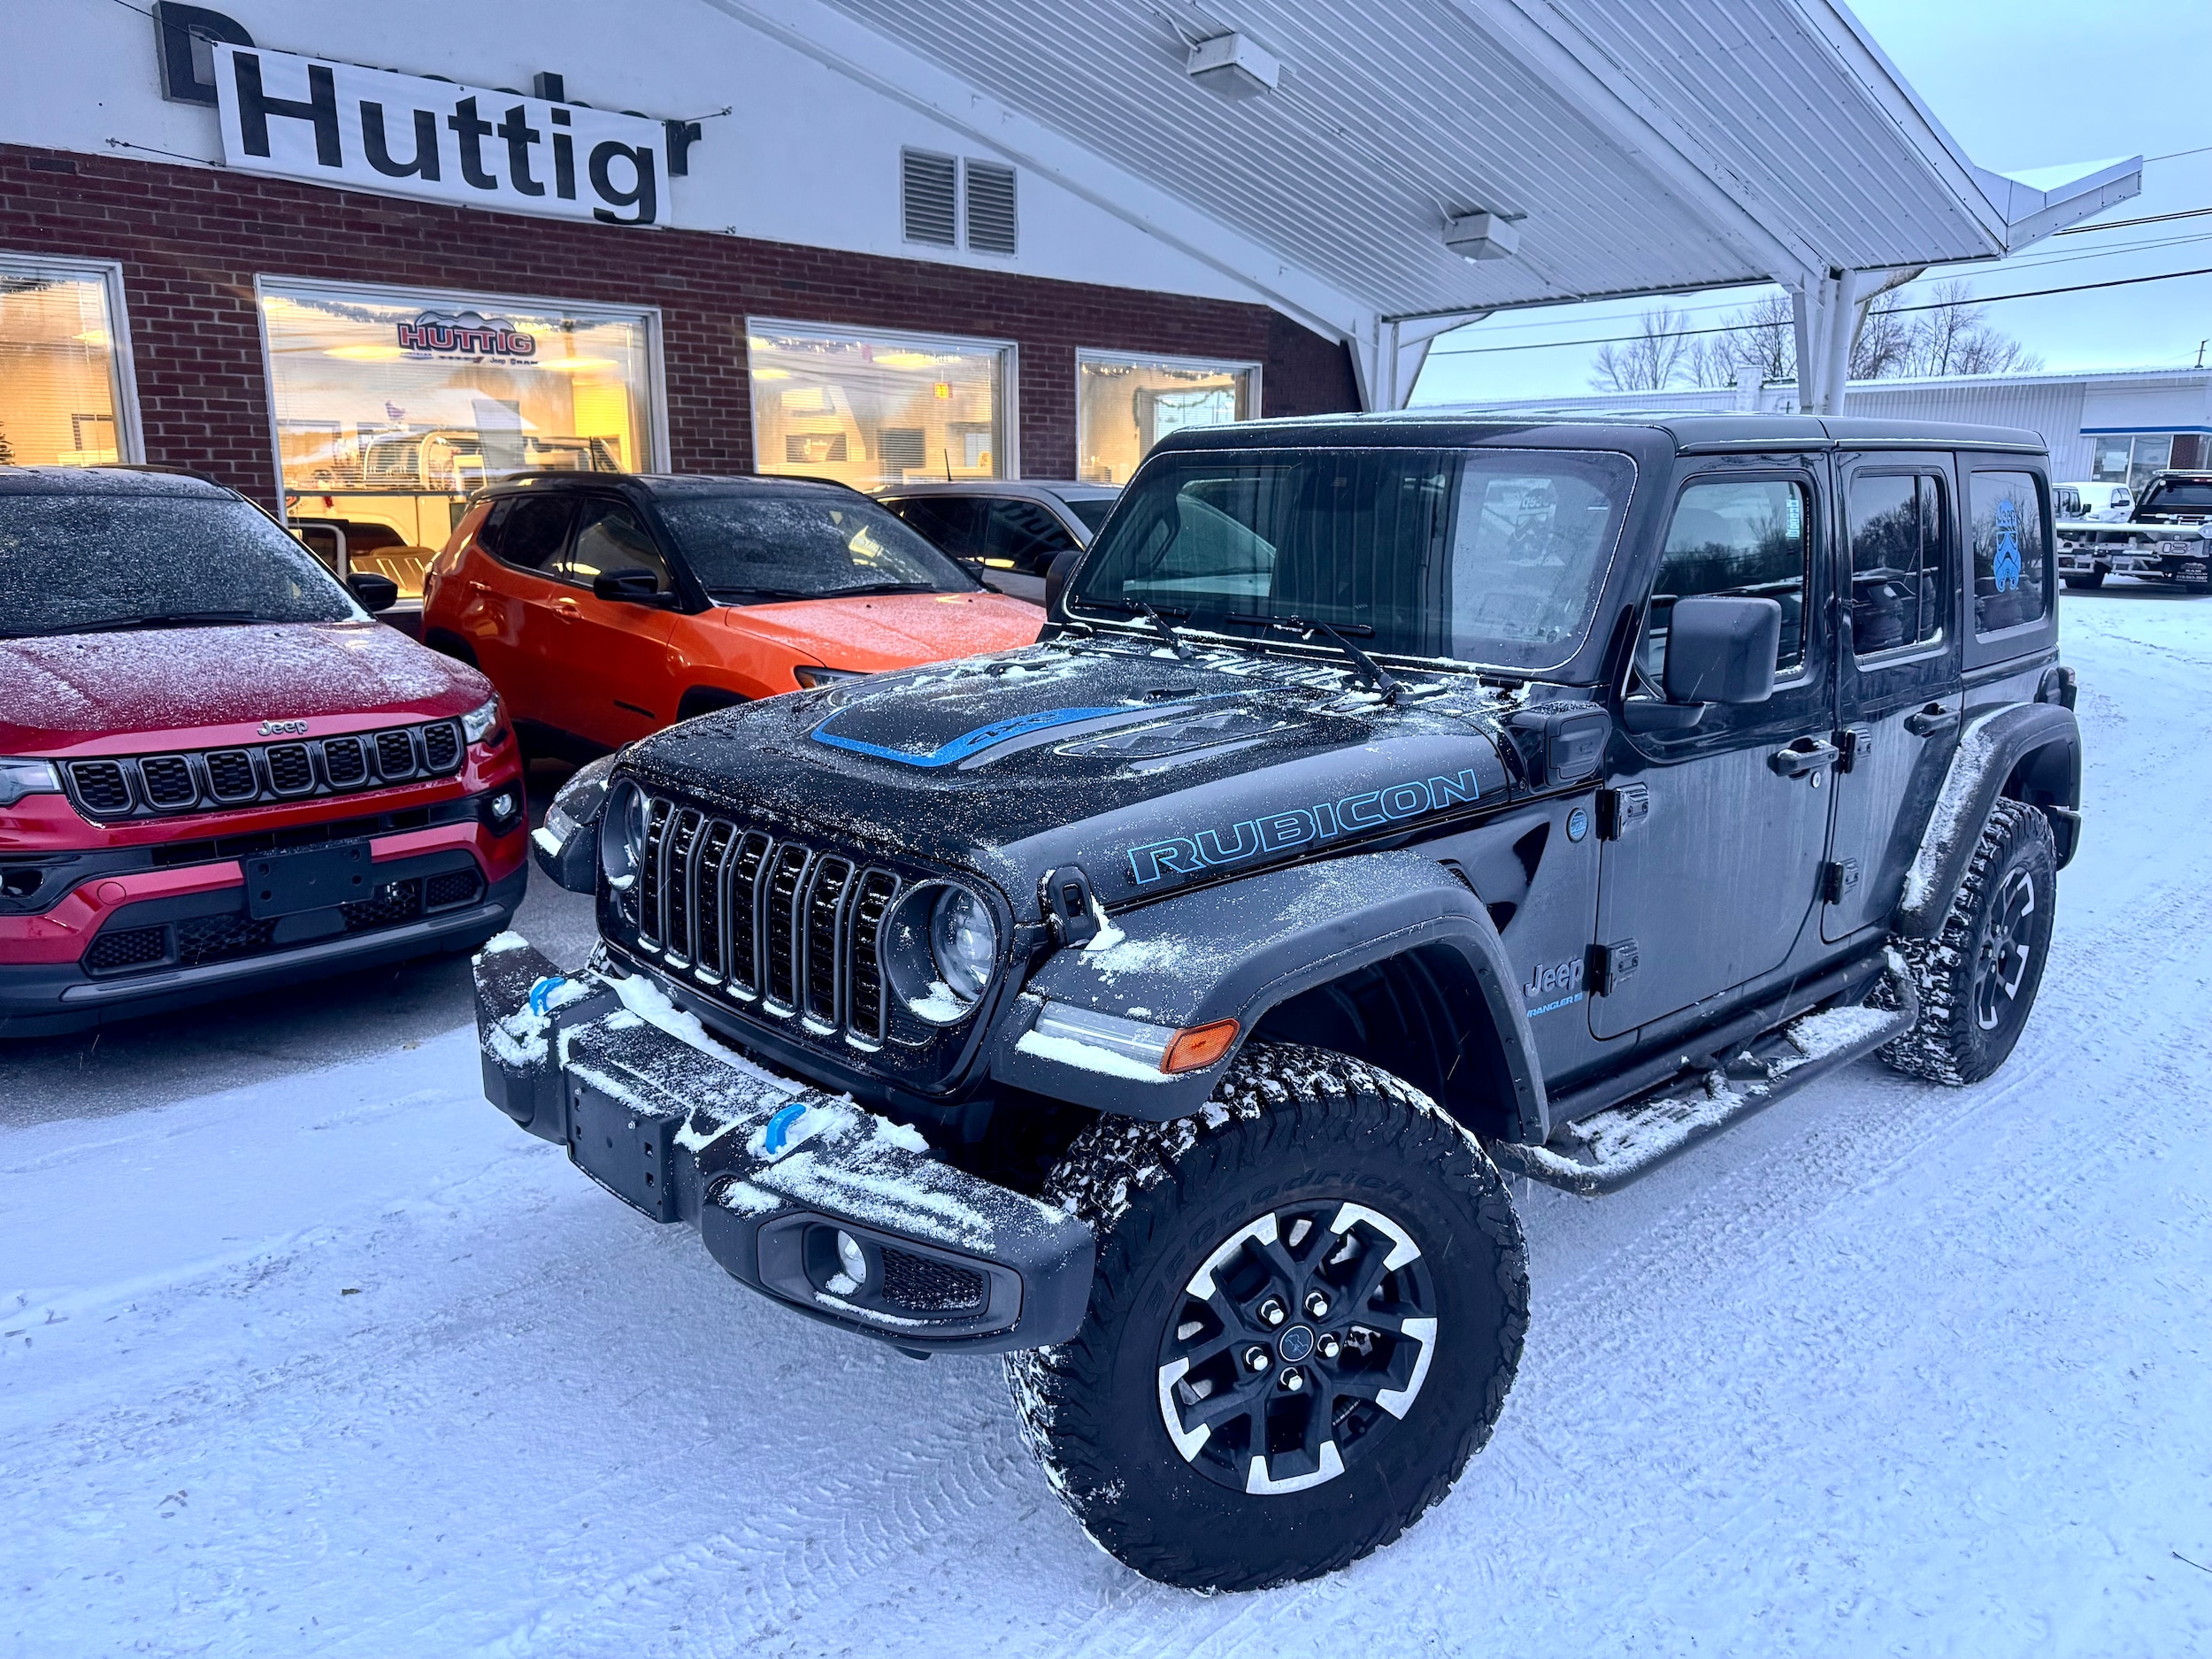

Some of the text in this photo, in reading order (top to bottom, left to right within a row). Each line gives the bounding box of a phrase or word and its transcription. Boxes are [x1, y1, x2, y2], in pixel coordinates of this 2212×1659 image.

[232, 50, 657, 225] Huttig
[398, 324, 535, 356] HUTTIG
[257, 719, 308, 736] Jeep
[1127, 769, 1479, 884] RUBICON
[1524, 958, 1584, 998] Jeep
